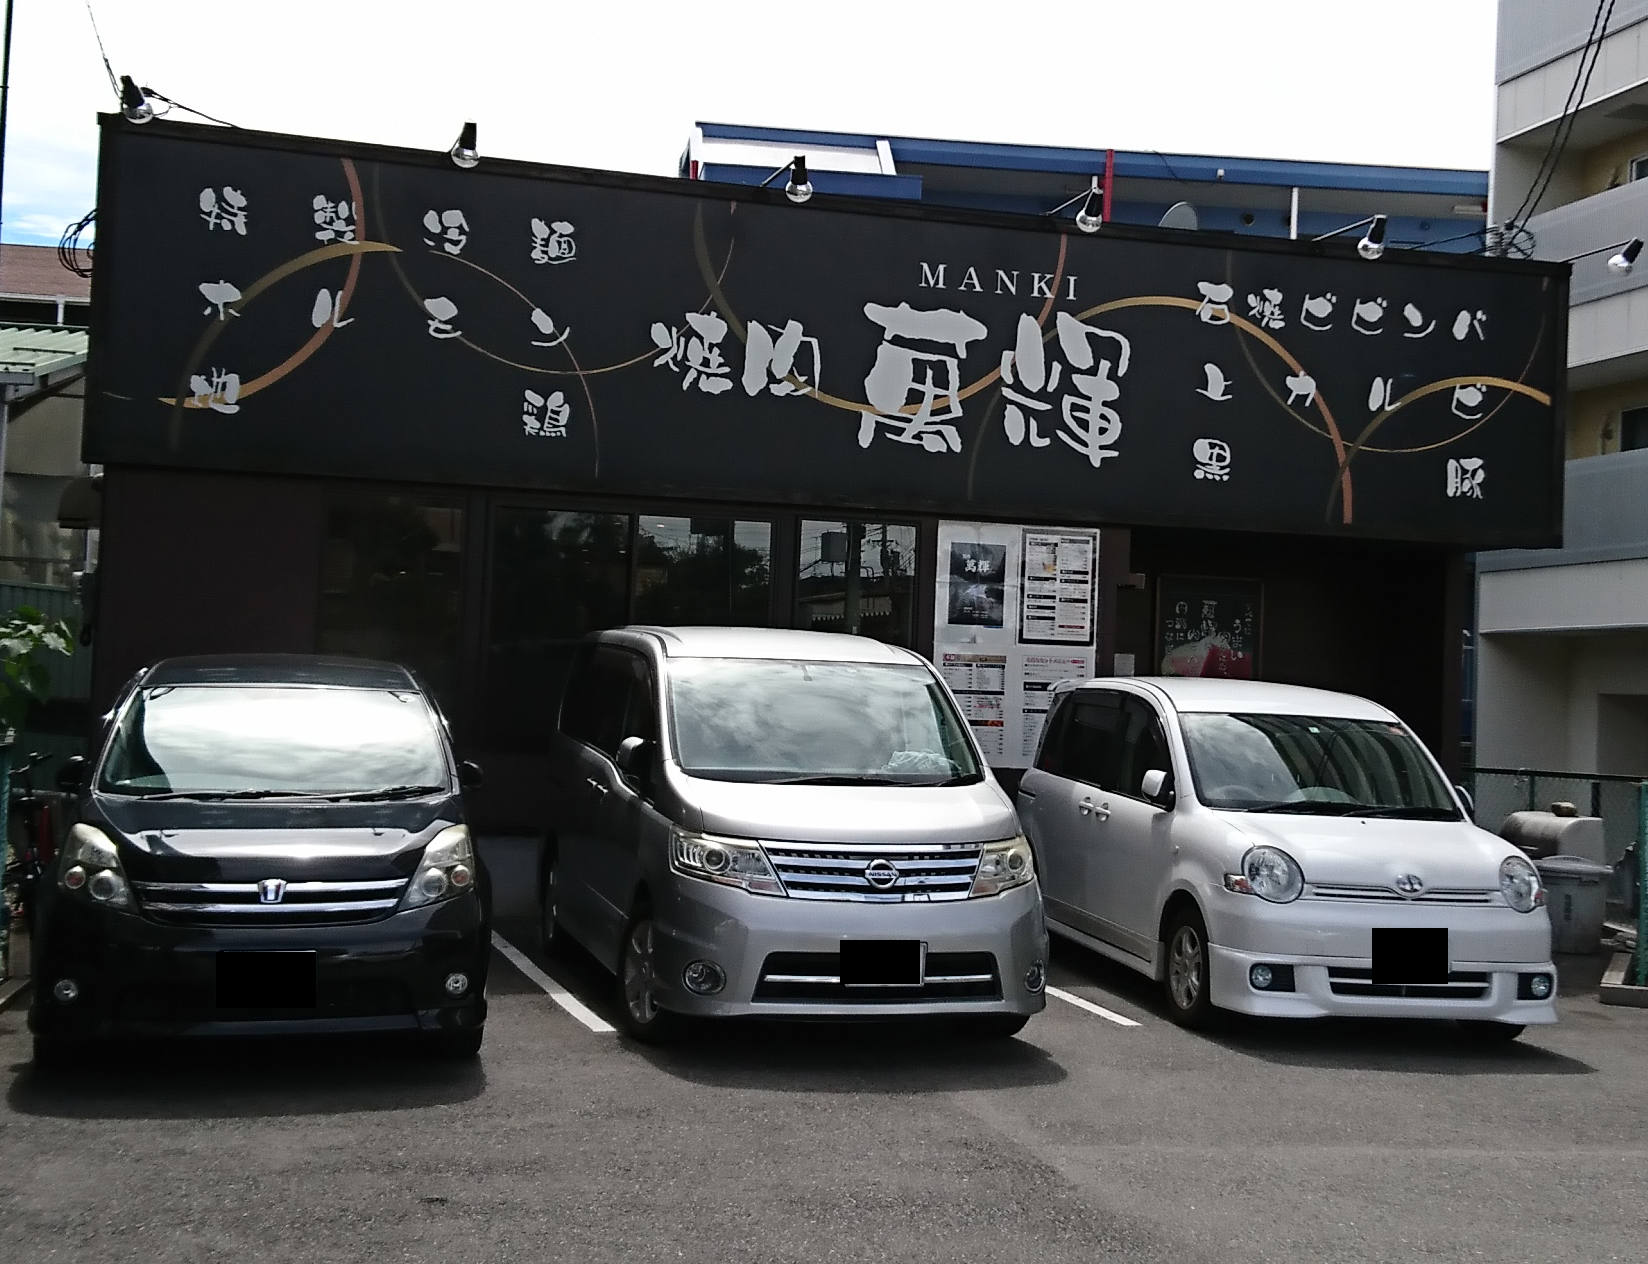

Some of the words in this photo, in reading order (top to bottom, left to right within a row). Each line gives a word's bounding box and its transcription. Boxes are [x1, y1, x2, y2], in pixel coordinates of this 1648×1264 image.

[918, 262, 1078, 300] MANKI
[198, 280, 571, 347] ホルモン
[1196, 282, 1487, 341] 石焼ビビンバ
[650, 311, 821, 397] 焼肉
[1195, 362, 1487, 420] 上カルビ
